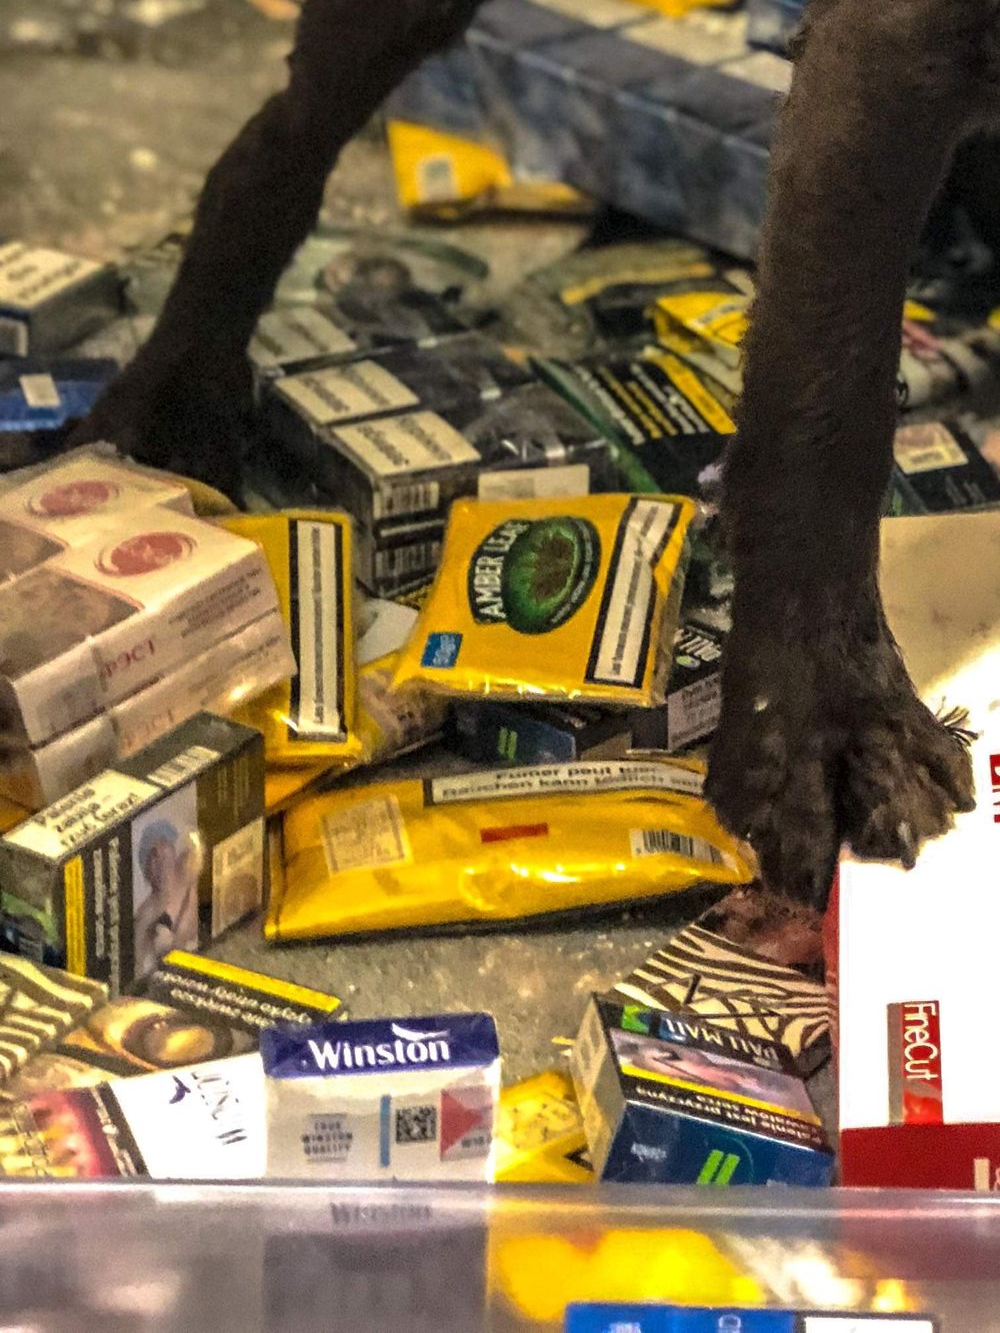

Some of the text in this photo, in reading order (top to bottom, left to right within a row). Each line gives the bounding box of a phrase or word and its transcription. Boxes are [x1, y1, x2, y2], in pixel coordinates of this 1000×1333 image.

[474, 554, 508, 619] AMBER
[307, 1037, 450, 1070] Winston
[663, 1017, 724, 1046] MALL
[903, 1003, 938, 1081] FineCut
